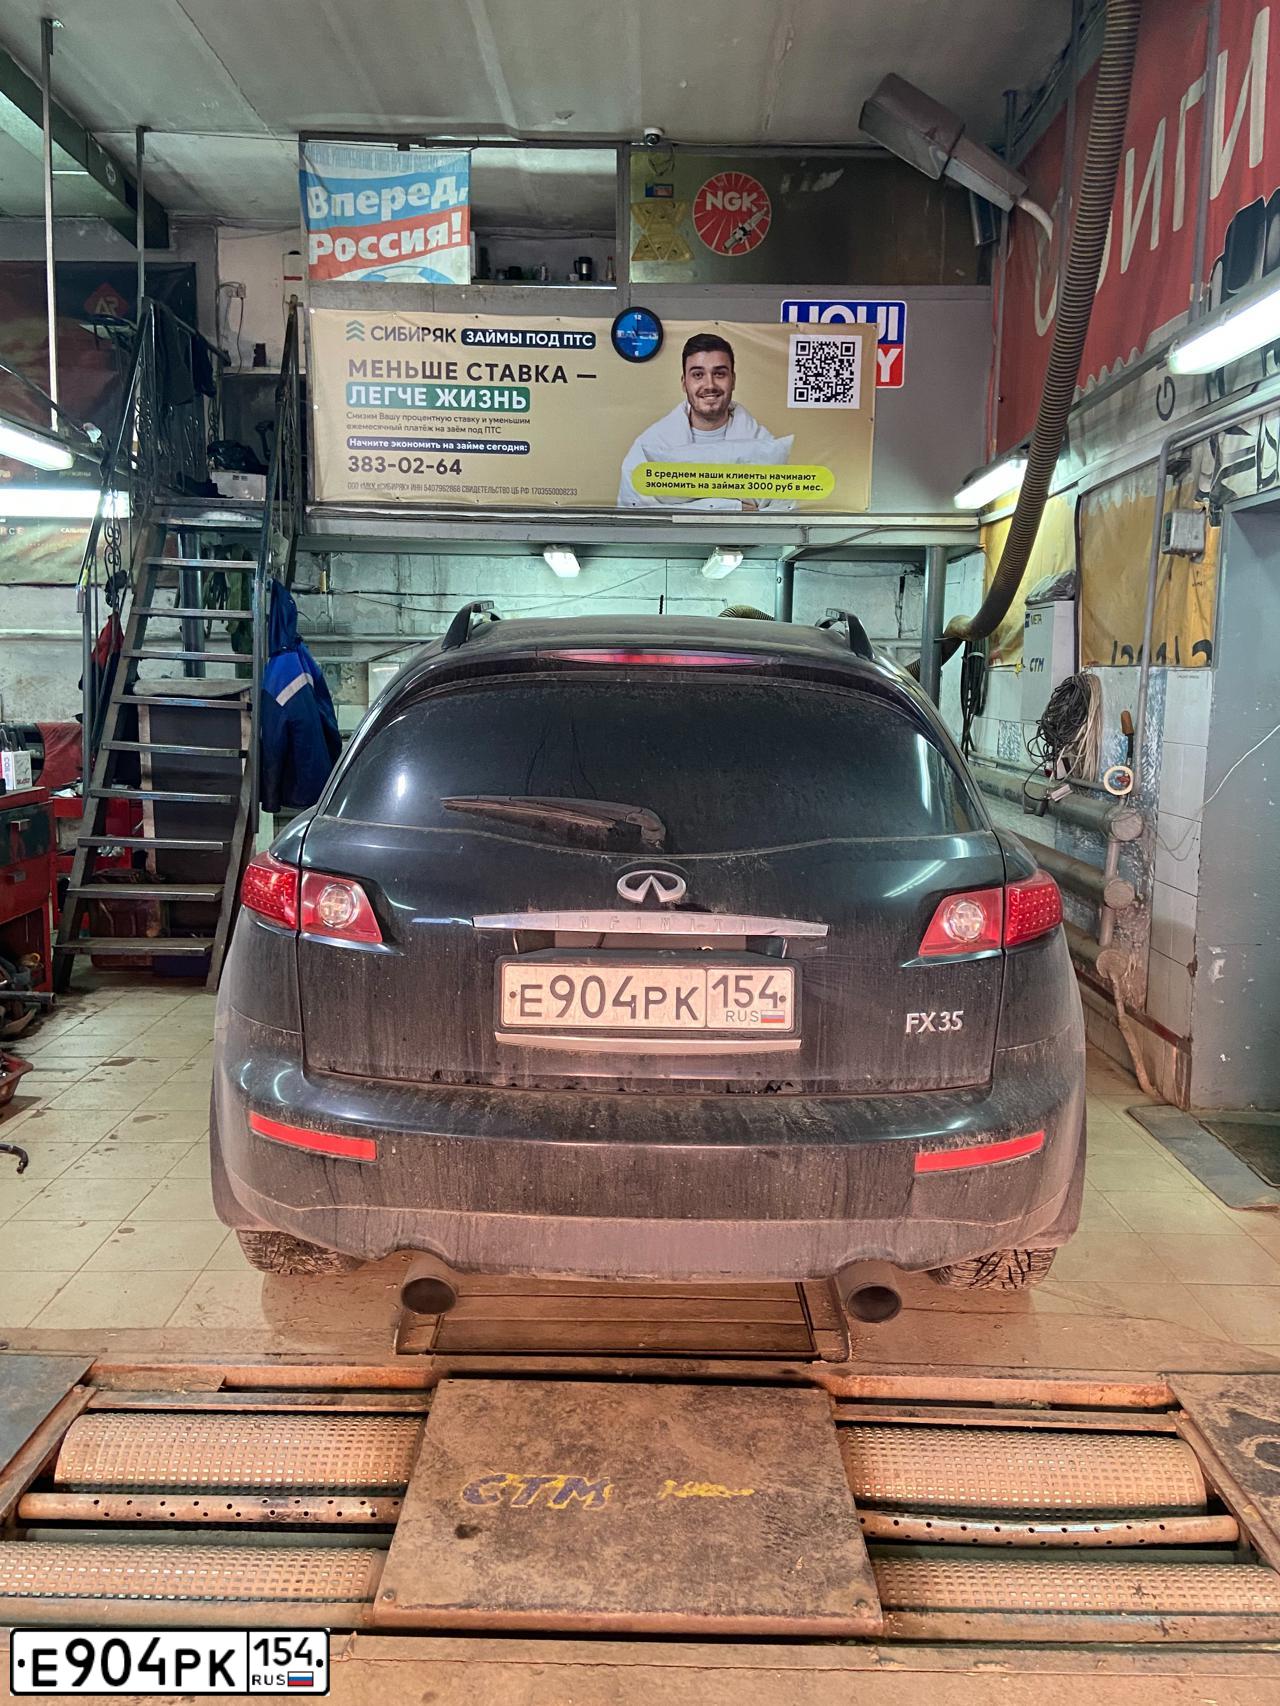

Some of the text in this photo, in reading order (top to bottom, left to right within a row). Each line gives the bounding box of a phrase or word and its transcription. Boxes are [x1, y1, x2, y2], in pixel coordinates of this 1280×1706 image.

[1034, 6, 1270, 337] ОИГИ
[705, 190, 759, 213] NGK
[308, 211, 463, 265] Россия!
[370, 325, 593, 347] СИБИРЯК ЗАЙМЫ ПОД ПТС
[348, 359, 458, 380] МЕНЬШЕ
[466, 362, 569, 384] СТАВКА
[349, 385, 527, 410] ЛЕГЧЕ ЖИЗНЬ
[346, 411, 377, 420] Снизим
[379, 413, 400, 421] Вашу
[402, 414, 452, 424] процентную
[346, 423, 402, 431] ежемесячный
[404, 424, 433, 432] платёж
[484, 426, 502, 434] ПТС
[349, 438, 389, 448] Начните
[390, 440, 441, 449] экономить
[456, 441, 485, 450] займе
[486, 444, 528, 452] сегодня:
[347, 455, 462, 475] 383-02-64
[646, 469, 653, 478] В
[654, 471, 696, 480] среднем
[461, 485, 510, 494] СВИДЕТЕЛЬСТВО
[646, 481, 696, 489] экономить
[711, 481, 746, 490] займах
[748, 482, 773, 491] 3000
[775, 482, 794, 493] руб
[554, 914, 748, 934] INFINITI
[711, 974, 779, 1009] 154
[725, 1010, 759, 1022] RUS
